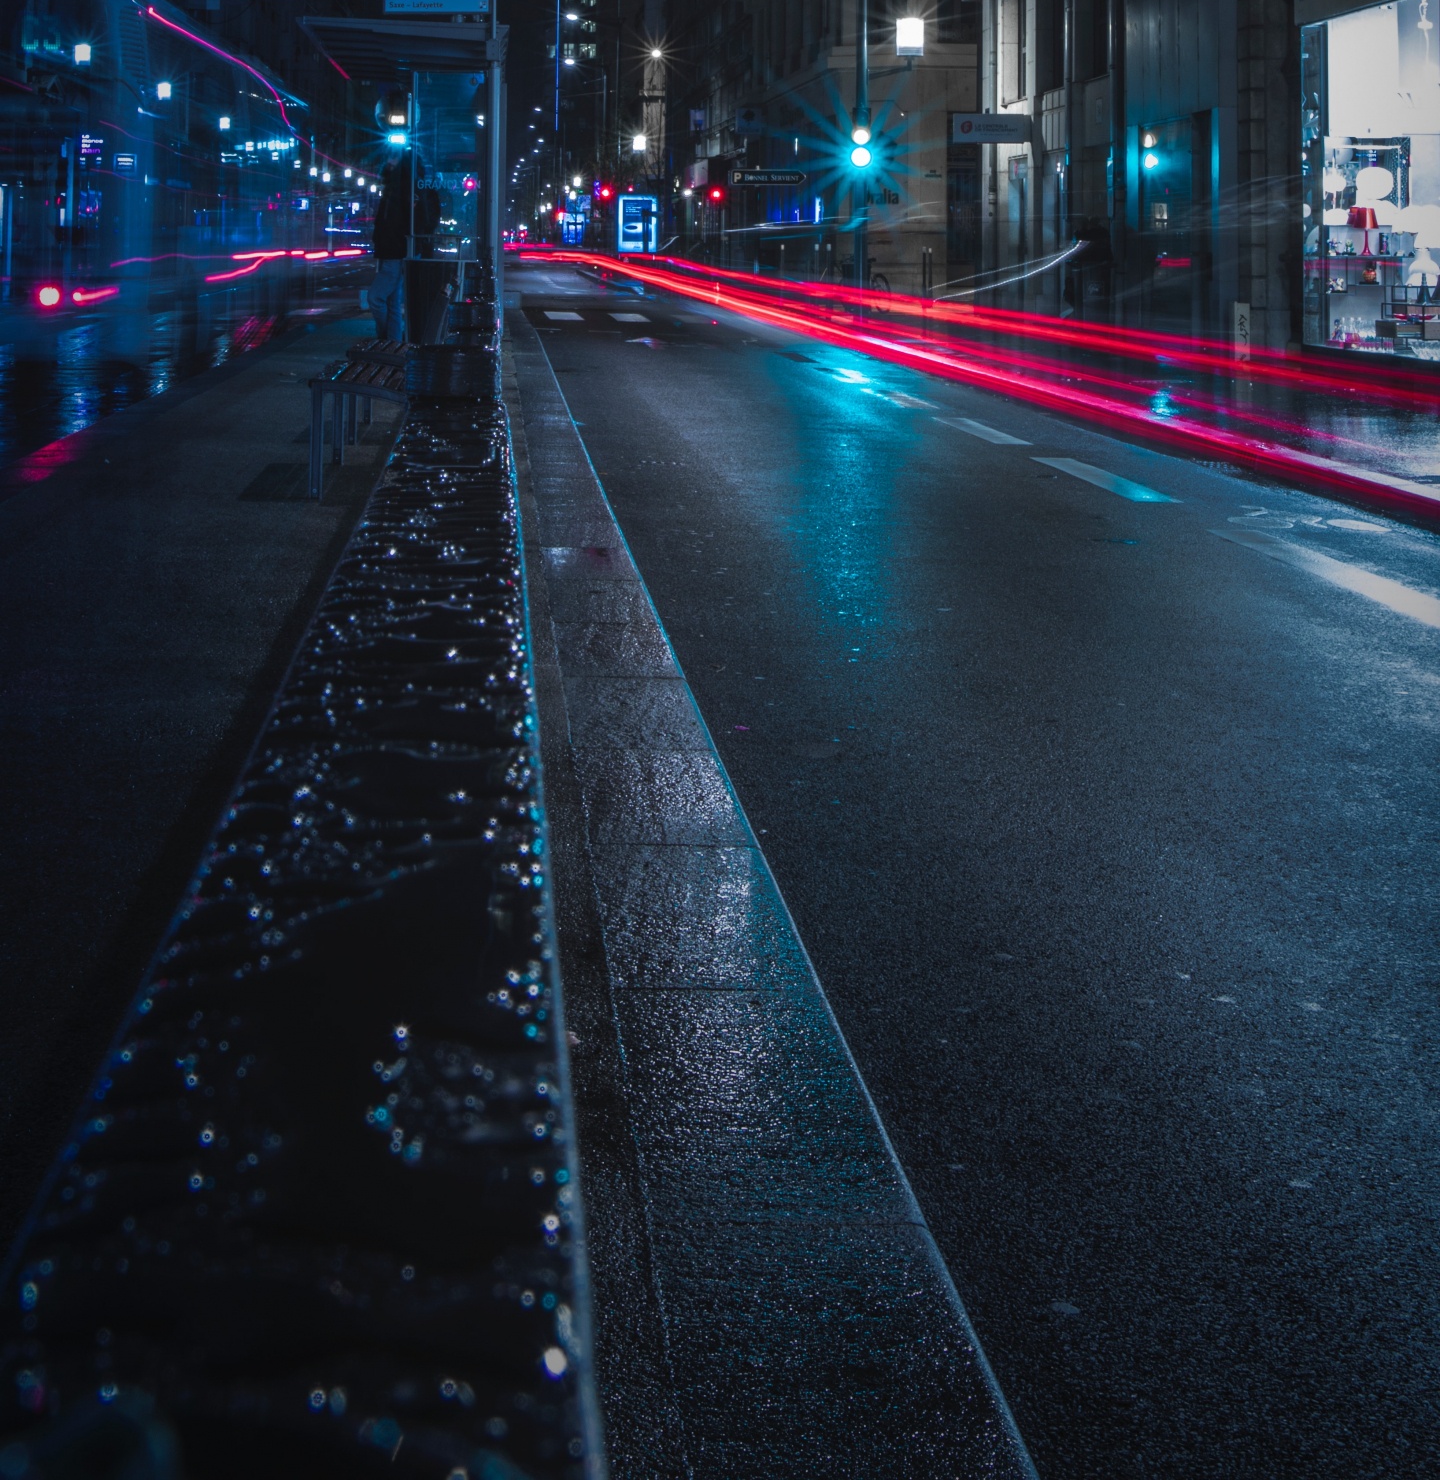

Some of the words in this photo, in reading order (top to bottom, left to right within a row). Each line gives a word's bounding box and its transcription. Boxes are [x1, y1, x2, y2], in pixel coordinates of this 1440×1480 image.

[389, 1, 405, 9] Saxe
[412, 1, 443, 9] Lafayette
[770, 173, 800, 182] SERVIENT
